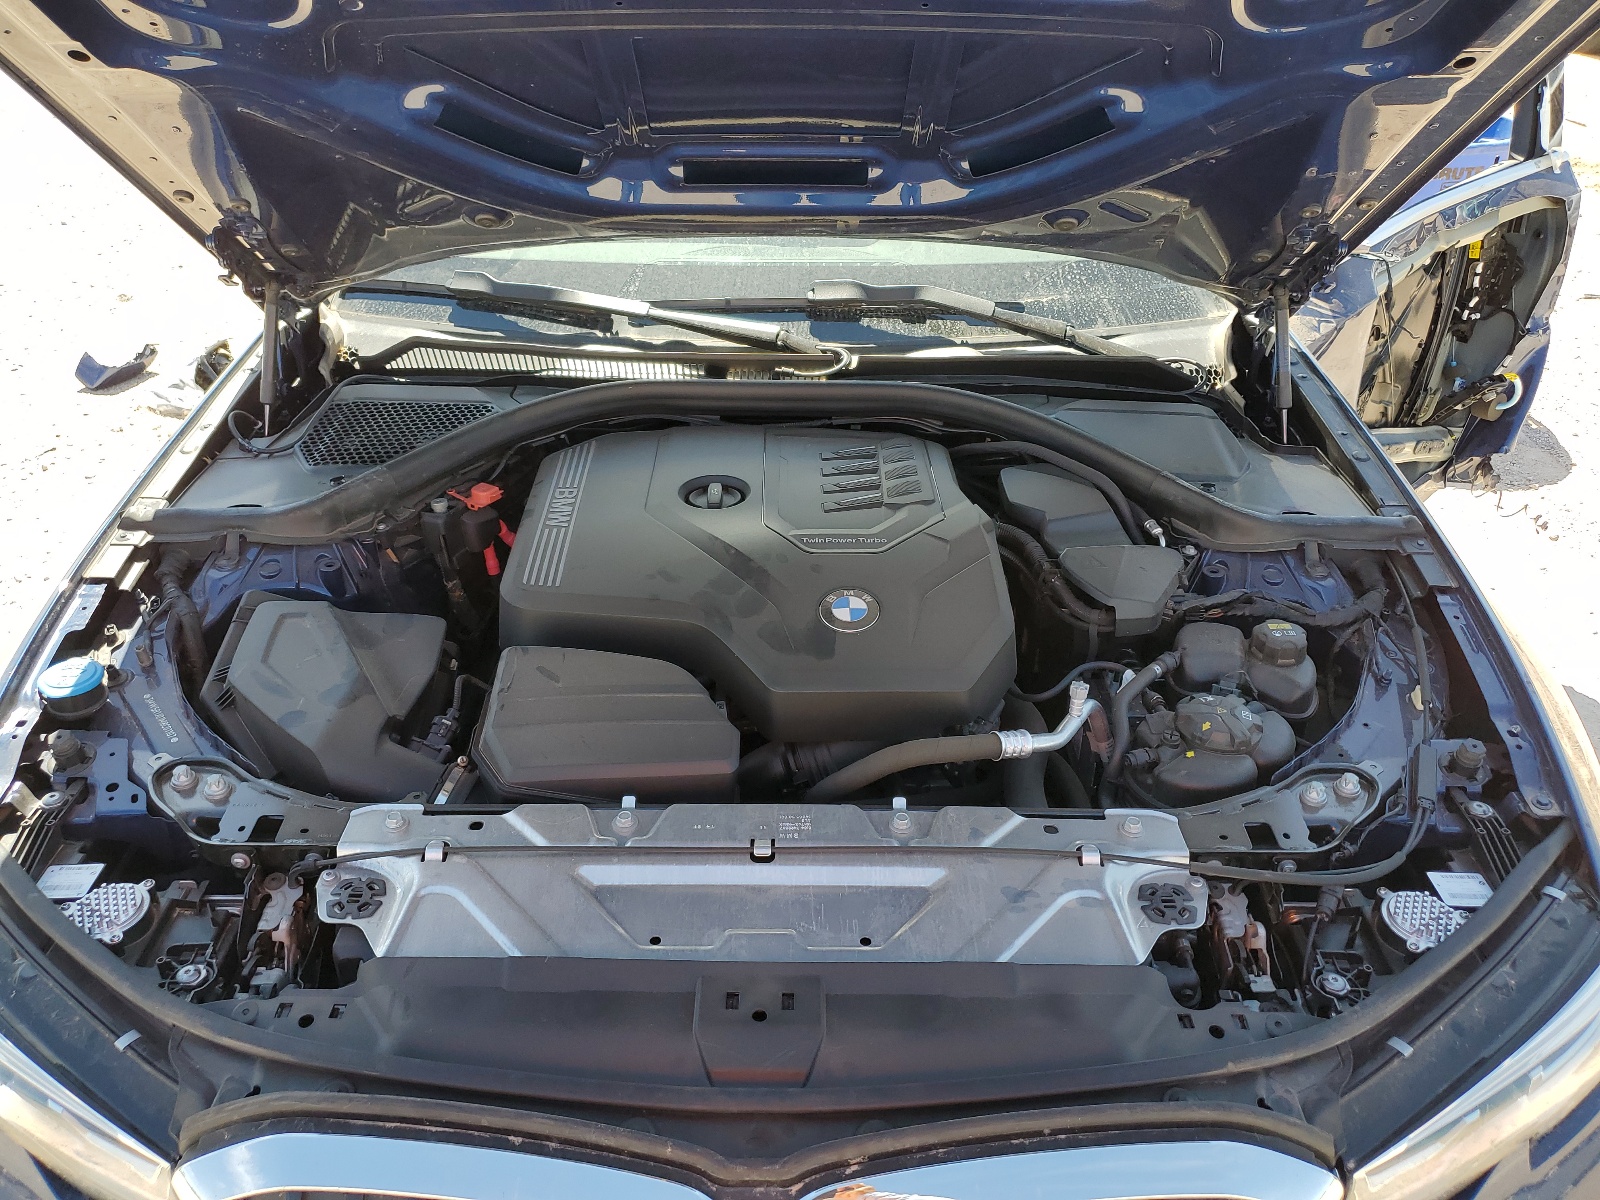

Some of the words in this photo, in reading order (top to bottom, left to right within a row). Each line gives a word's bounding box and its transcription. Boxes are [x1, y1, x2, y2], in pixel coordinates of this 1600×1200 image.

[1434, 166, 1485, 180] RUT
[545, 488, 578, 527] BMW
[825, 589, 874, 603] BMW
